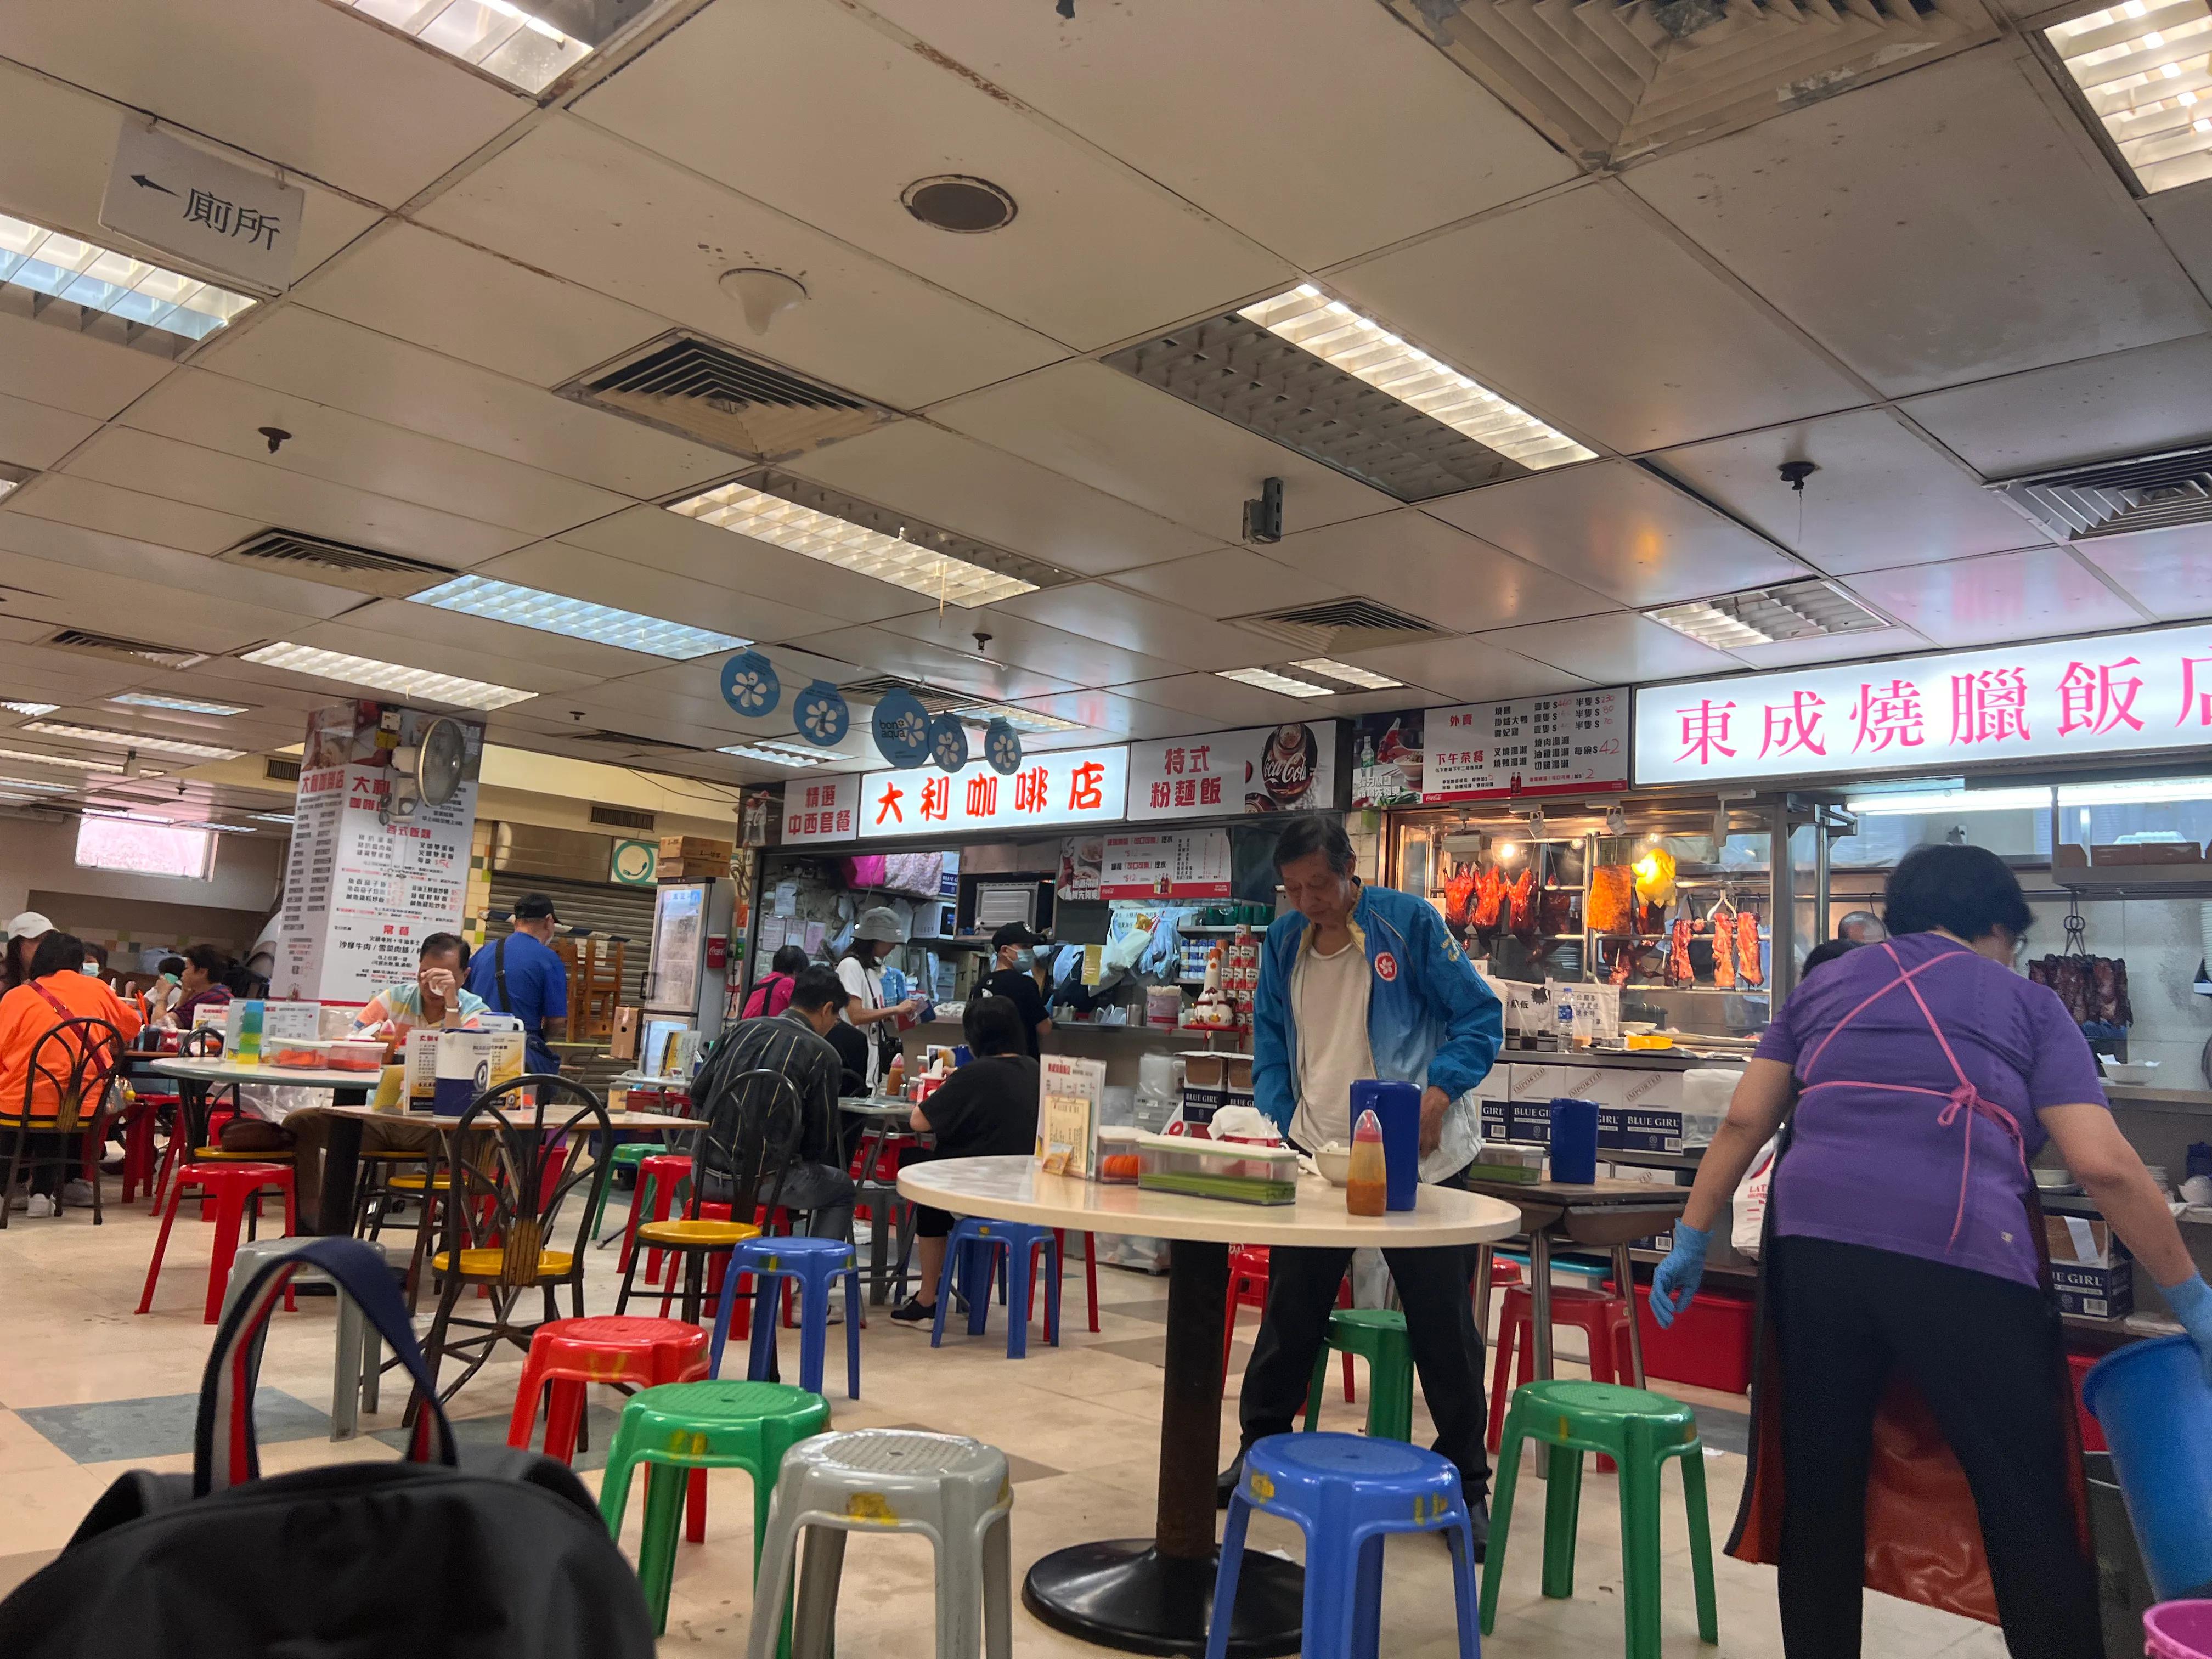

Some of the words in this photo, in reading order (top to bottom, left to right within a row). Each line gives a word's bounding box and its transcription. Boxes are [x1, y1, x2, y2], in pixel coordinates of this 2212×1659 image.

[183, 188, 280, 250] 廁所
[1576, 697, 1592, 707] 半隻
[1576, 709, 1592, 718] 半隻
[880, 720, 898, 729] bon
[1450, 714, 1472, 727] 外賣
[1576, 720, 1592, 730] 半隻
[881, 730, 906, 739] aqua
[1164, 745, 1210, 775] 特式
[1436, 751, 1484, 766] 下午茶餐
[805, 785, 836, 808] 精選
[876, 761, 1105, 825] 大利咖啡店
[1150, 776, 1221, 808] 粉麵飯
[788, 810, 850, 835] 中西套餐
[1513, 1066, 1546, 1093] IMPORTED
[1568, 1071, 1602, 1098] IMPORTED
[1626, 1074, 1662, 1101] IMPORTED
[1186, 1093, 1201, 1102] BLUE
[1203, 1094, 1218, 1103] GIRL
[1230, 1098, 1245, 1107] BLUE
[1483, 1107, 1504, 1115] GIRL
[1514, 1107, 1537, 1116] BLUE
[1538, 1109, 1551, 1117] GI
[1627, 1116, 1652, 1125] BLUE
[1655, 1118, 1679, 1127] GIRL
[1750, 1184, 1768, 1193] LAT
[2067, 1273, 2103, 1286] GIRL
